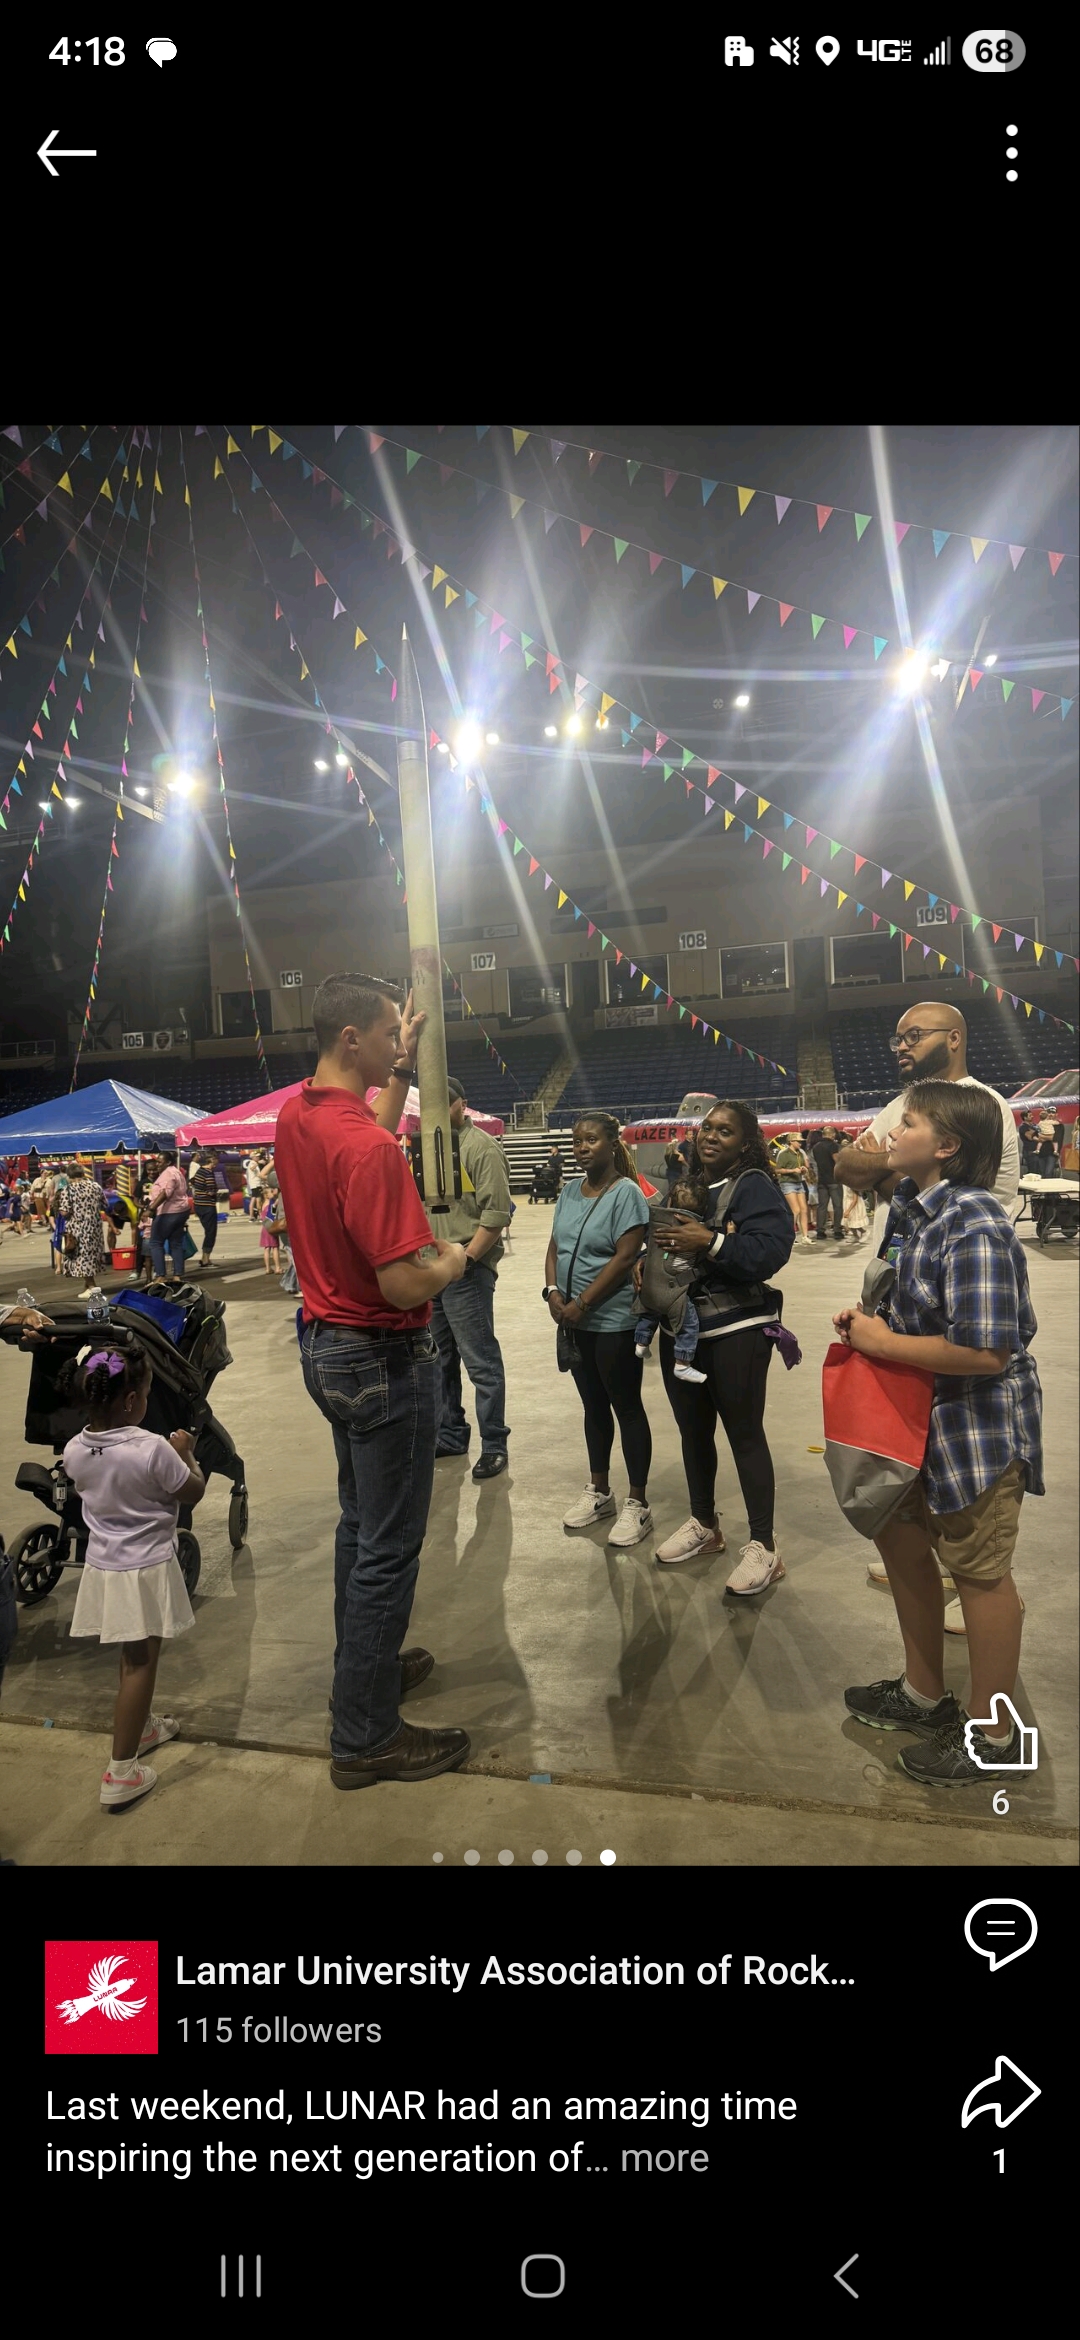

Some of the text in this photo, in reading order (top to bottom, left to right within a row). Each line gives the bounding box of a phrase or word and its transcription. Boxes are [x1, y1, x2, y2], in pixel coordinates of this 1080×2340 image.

[918, 906, 946, 924] 109
[681, 933, 705, 949] 108
[472, 954, 495, 969] 107
[281, 971, 301, 986] 106
[123, 1034, 142, 1048] 105
[634, 1127, 677, 1140] LAZER
